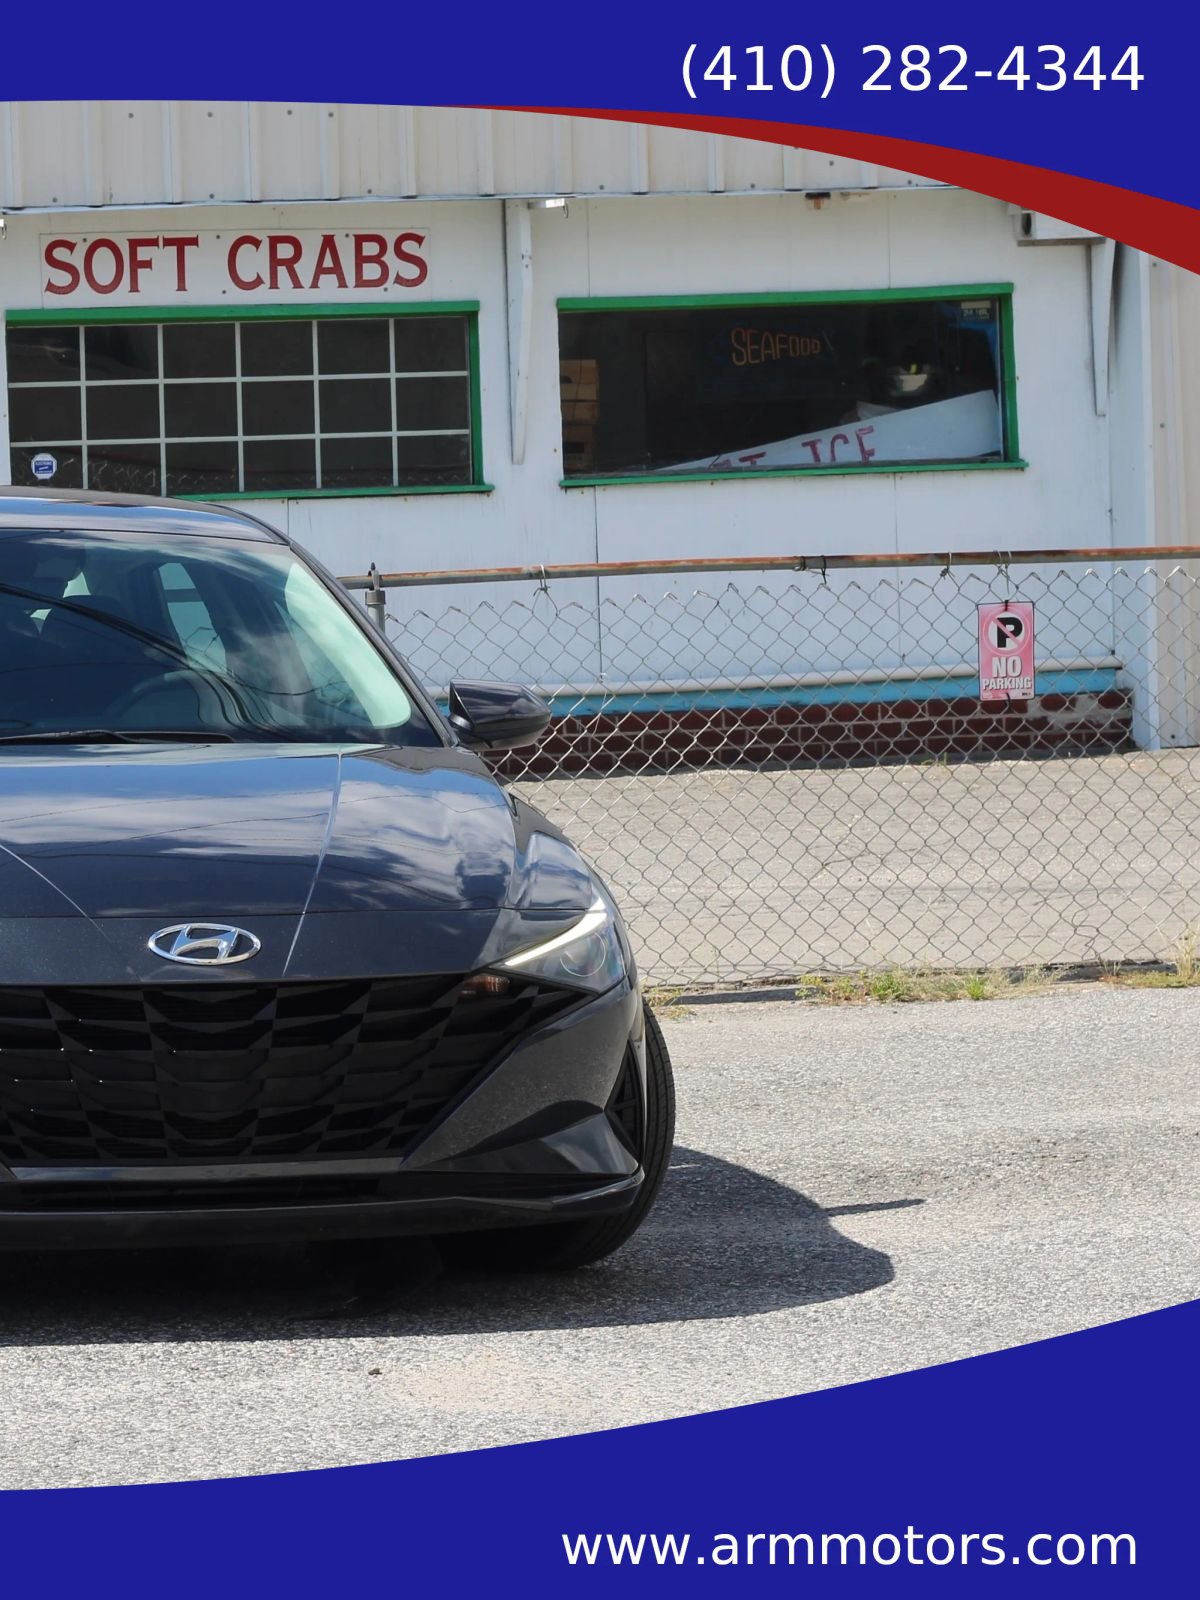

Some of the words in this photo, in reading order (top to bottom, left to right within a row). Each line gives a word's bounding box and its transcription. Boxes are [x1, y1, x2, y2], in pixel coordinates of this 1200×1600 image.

[44, 234, 199, 295] SOFT
[227, 232, 428, 291] CRABS
[730, 326, 821, 366] SEAFOOD
[991, 656, 1022, 678] NO
[983, 676, 1032, 691] PARKING
